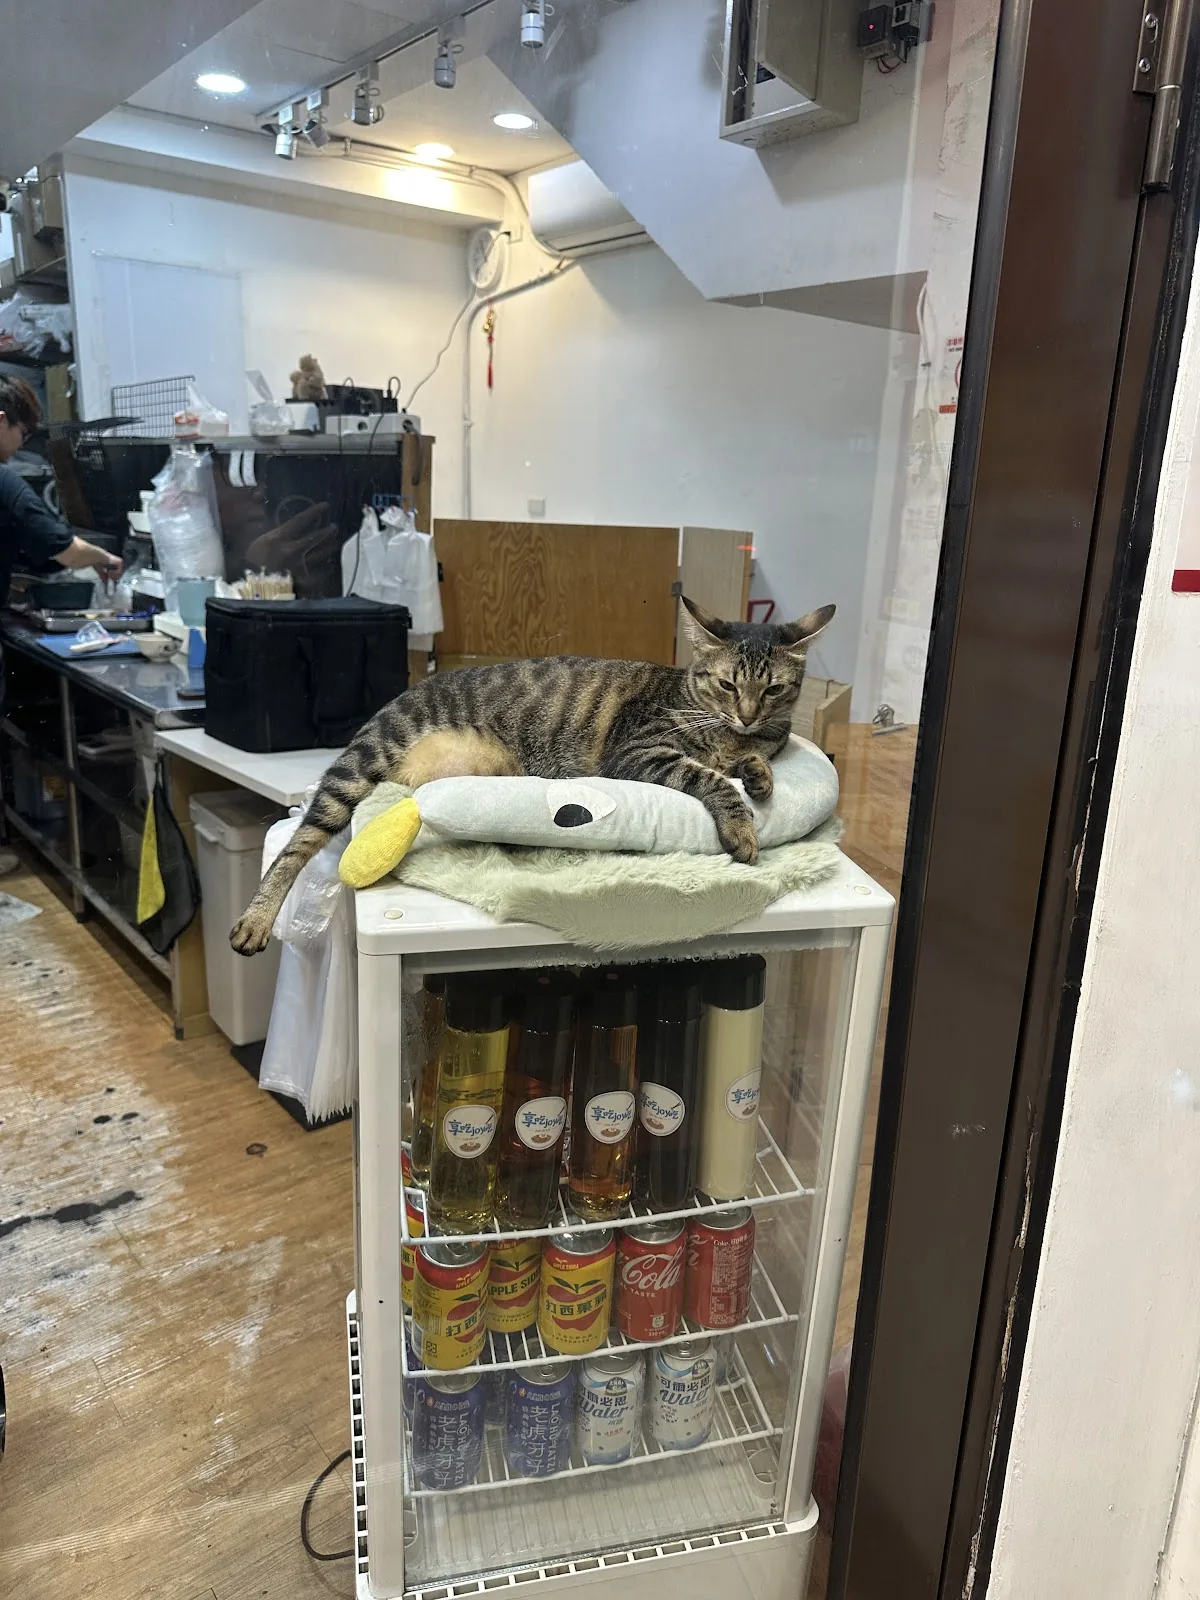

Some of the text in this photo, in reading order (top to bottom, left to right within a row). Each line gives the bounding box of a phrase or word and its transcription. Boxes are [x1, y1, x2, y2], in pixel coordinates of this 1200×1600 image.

[621, 1245, 685, 1291] Cola
[630, 1286, 657, 1298] TASTE
[579, 1396, 629, 1419] Water
[659, 1383, 712, 1406] Water
[435, 1415, 457, 1487] 老虎牙子
[527, 1405, 549, 1474] 老虎牙子
